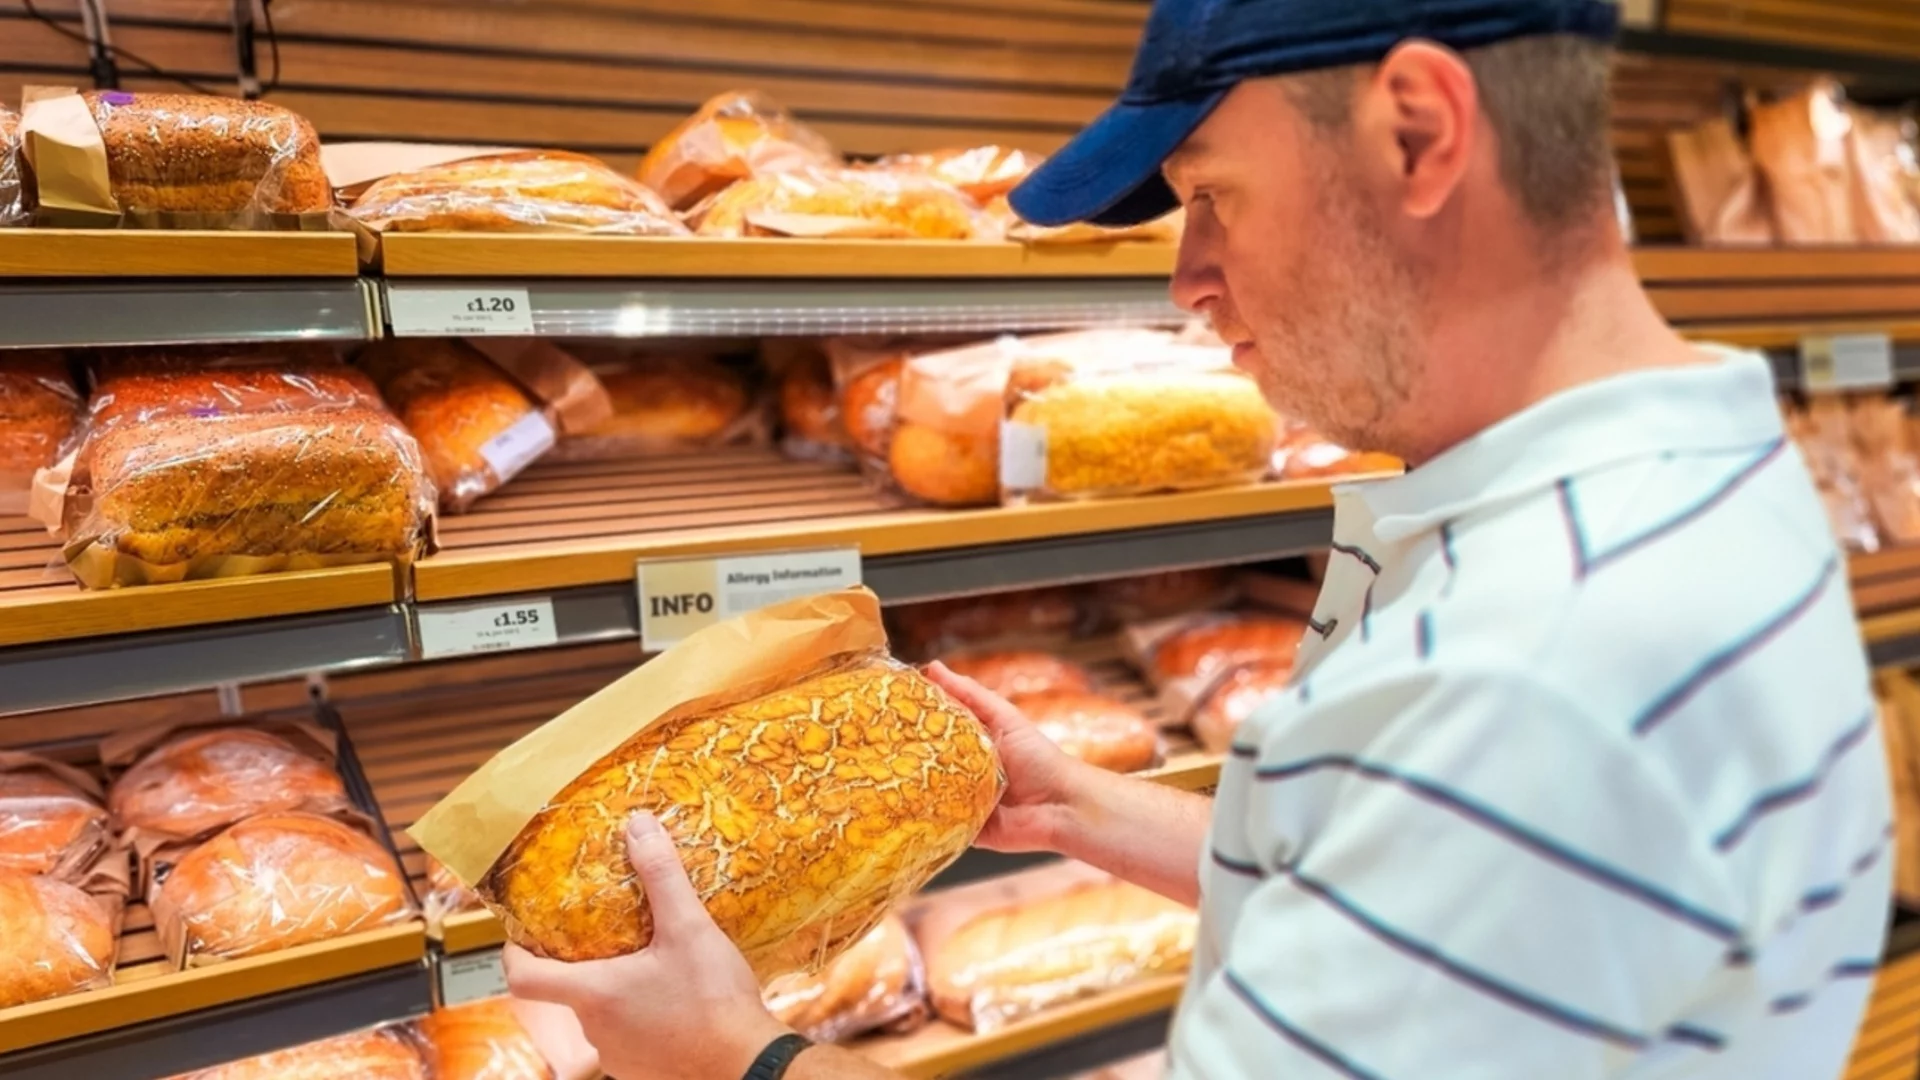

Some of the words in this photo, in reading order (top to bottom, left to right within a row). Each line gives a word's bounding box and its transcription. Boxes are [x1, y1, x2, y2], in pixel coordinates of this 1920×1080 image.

[467, 297, 515, 312] £1.20
[727, 572, 770, 585] Allergy
[773, 567, 842, 581] Information
[650, 592, 713, 617] INFO
[494, 609, 539, 626] £1.55
